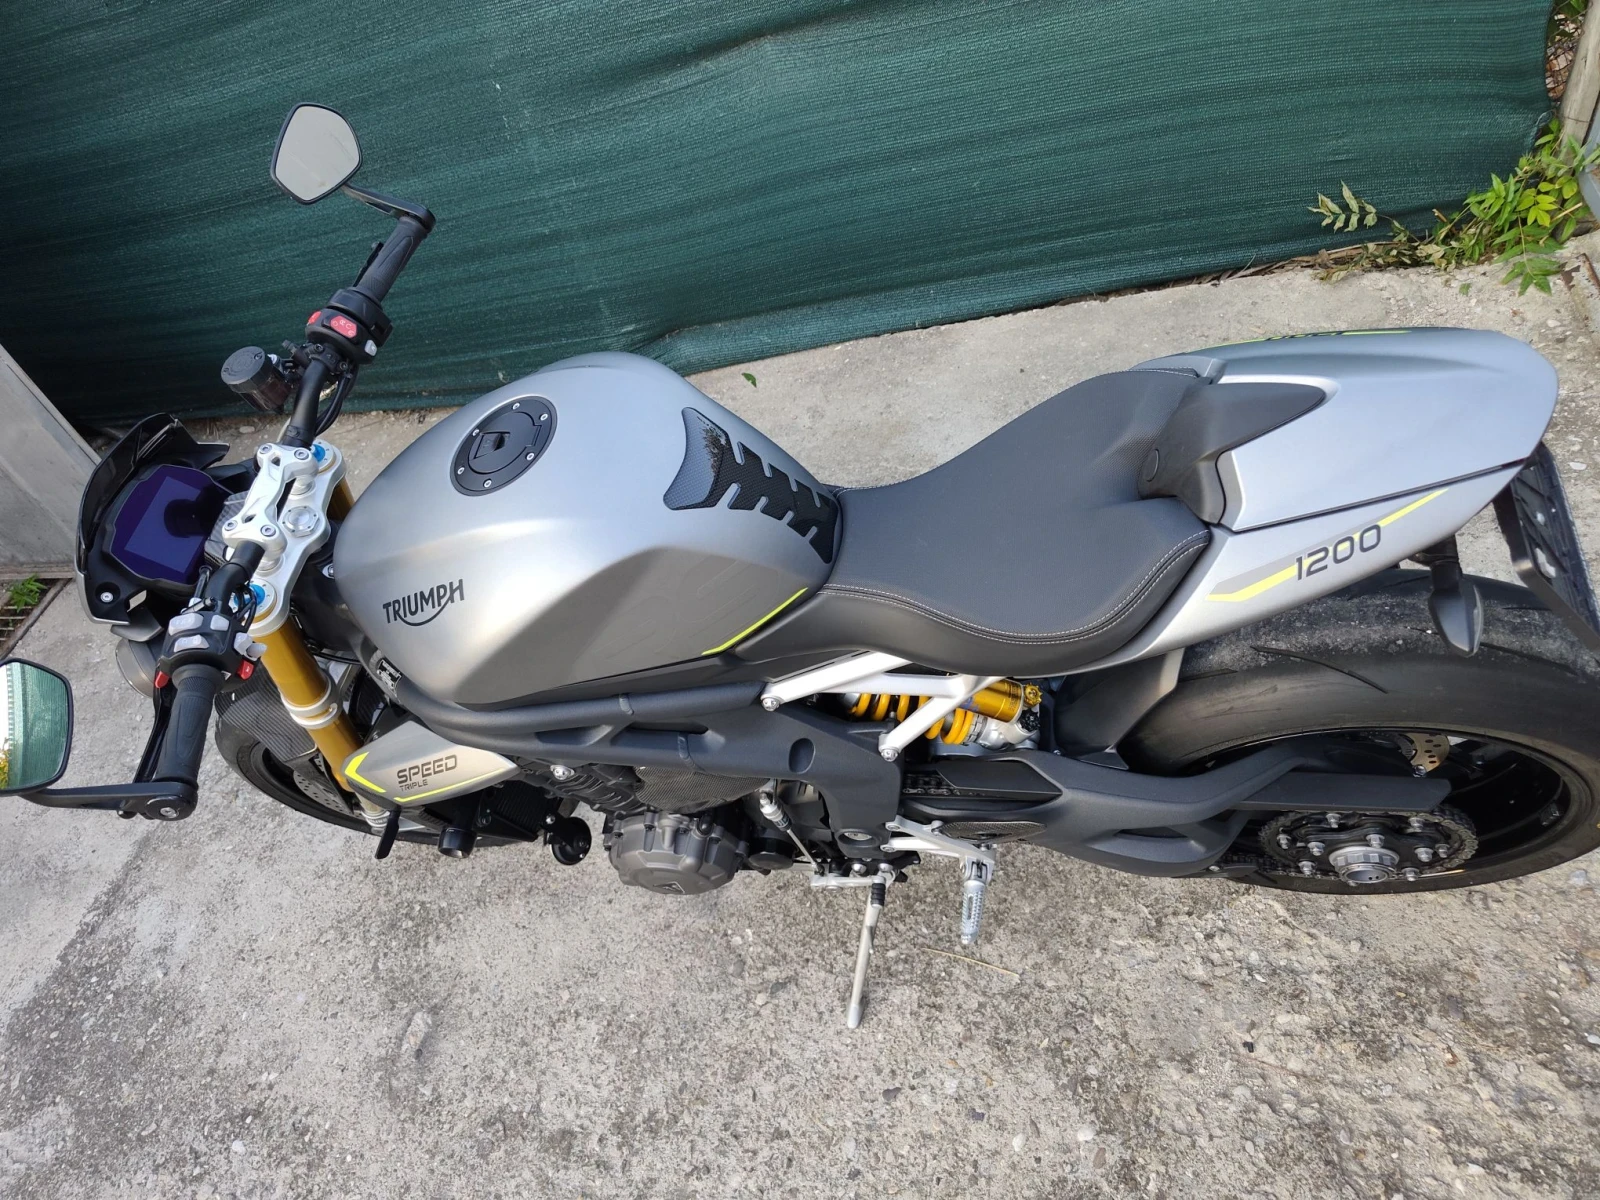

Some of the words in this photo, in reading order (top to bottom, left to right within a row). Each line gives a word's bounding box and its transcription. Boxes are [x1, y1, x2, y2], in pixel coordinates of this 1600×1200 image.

[1295, 524, 1381, 581] 1200
[382, 578, 465, 627] TRIUMPH
[396, 754, 457, 785] SPEED
[399, 778, 429, 792] TRIPLE
